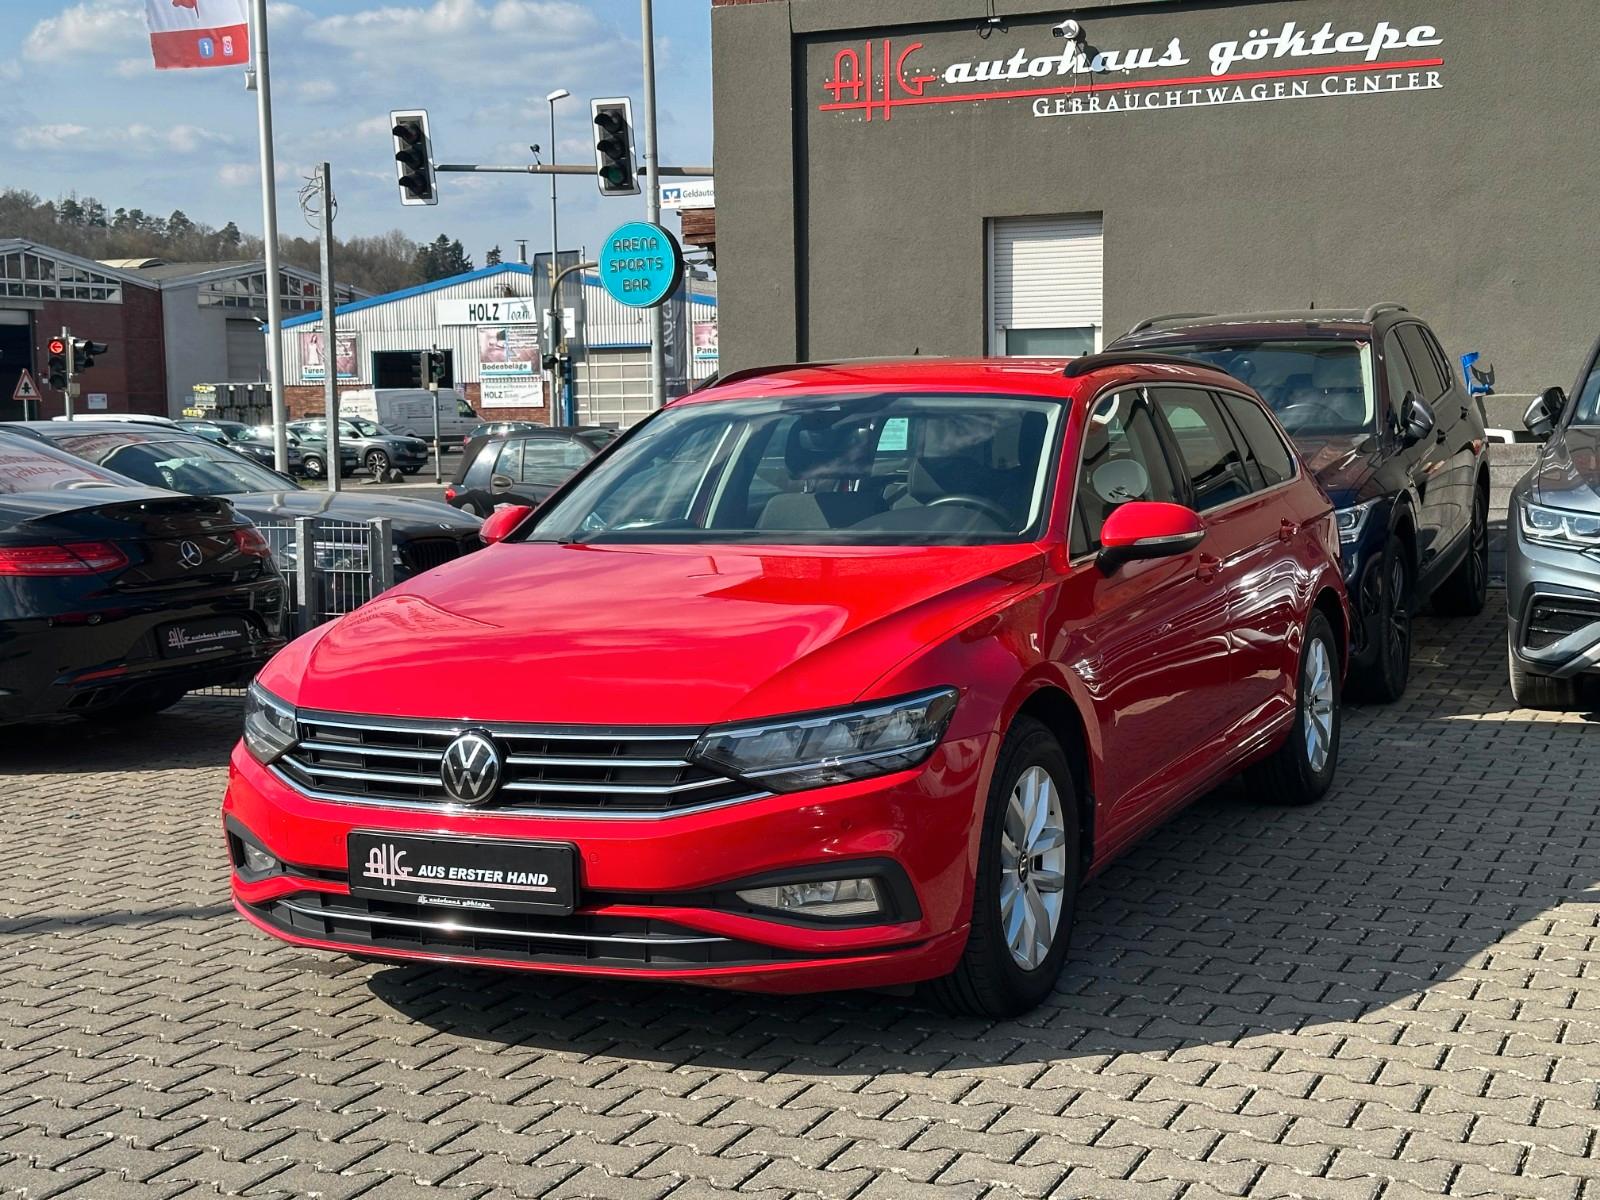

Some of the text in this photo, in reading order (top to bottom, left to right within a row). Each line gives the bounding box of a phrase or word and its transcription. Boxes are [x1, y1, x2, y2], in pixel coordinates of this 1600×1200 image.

[944, 36, 1191, 84] autohaus
[1208, 21, 1444, 76] göktepe
[1320, 71, 1443, 96] CENTER
[613, 237, 659, 252] ARENA
[609, 256, 664, 273] SPORTS
[622, 278, 651, 293] BAR
[468, 303, 500, 321] HOLZ
[484, 391, 503, 399] HOLZ
[418, 864, 446, 878] AUS
[448, 866, 503, 883] ERSTER
[506, 871, 549, 886] HAND
